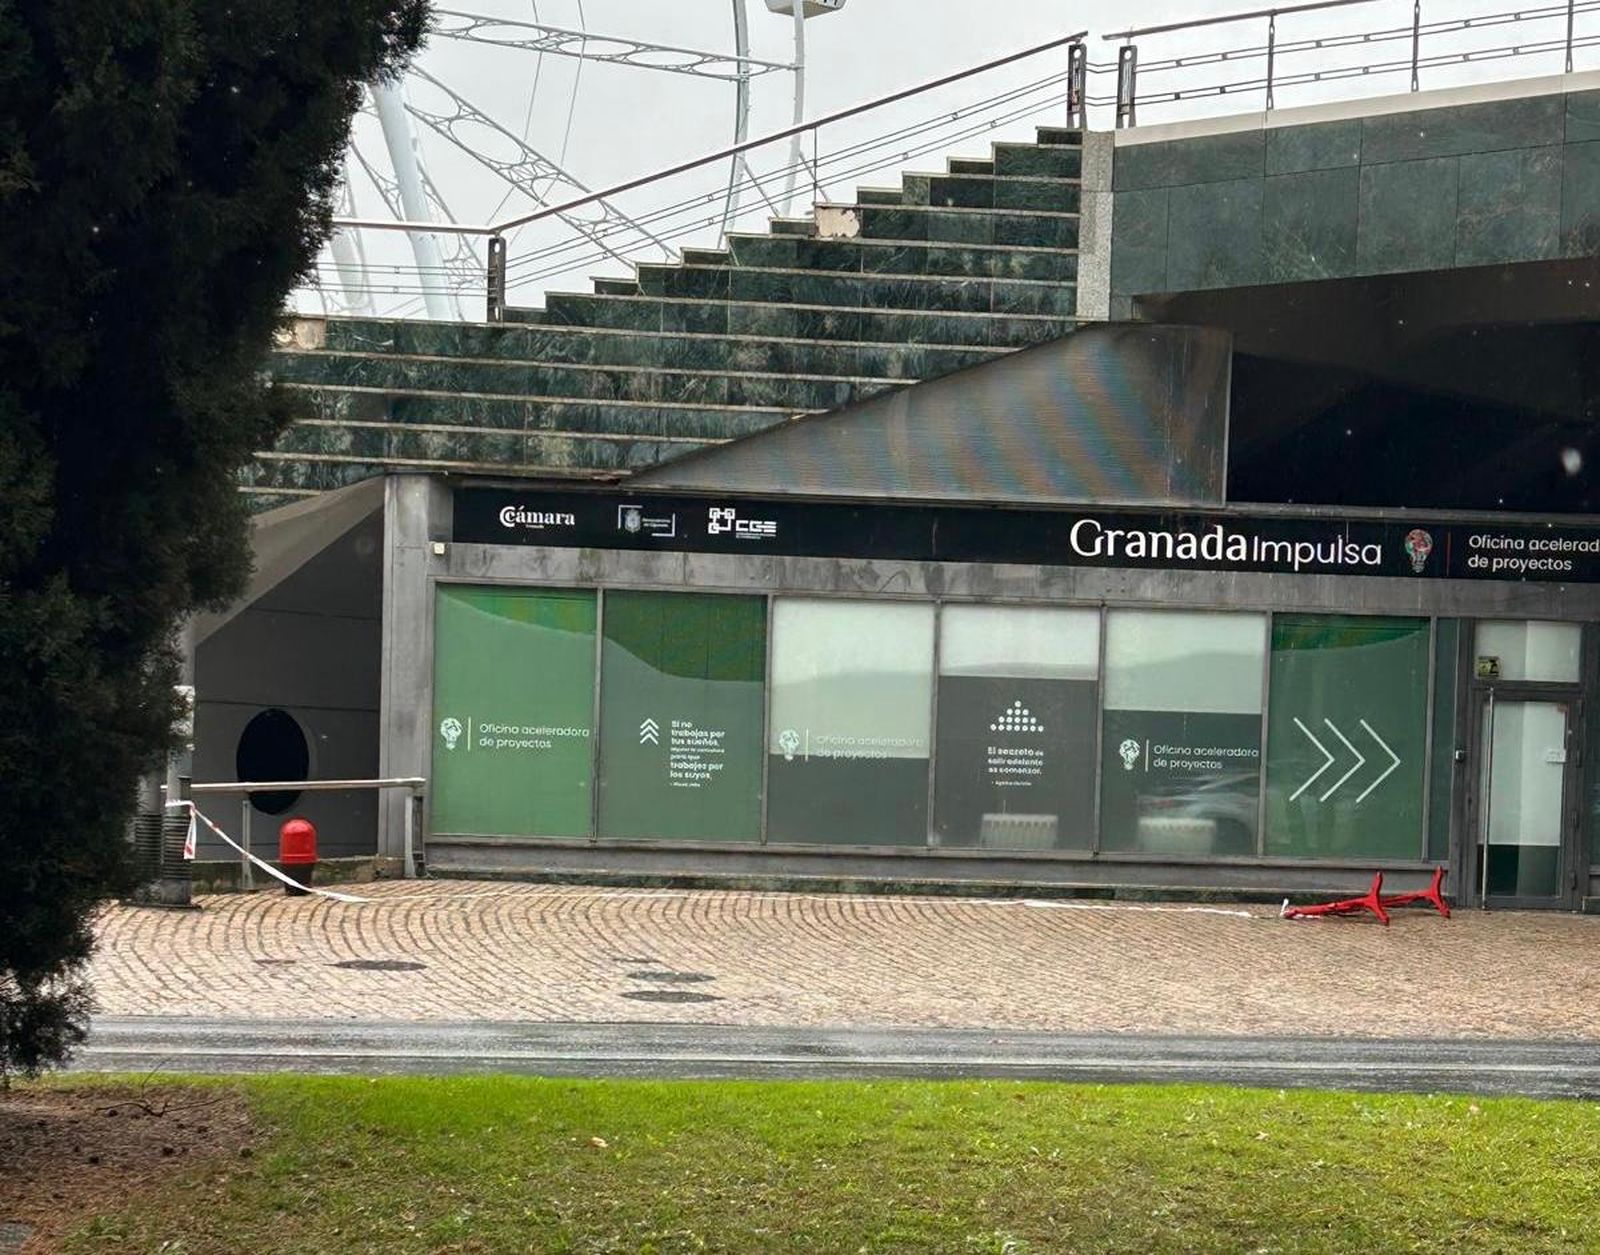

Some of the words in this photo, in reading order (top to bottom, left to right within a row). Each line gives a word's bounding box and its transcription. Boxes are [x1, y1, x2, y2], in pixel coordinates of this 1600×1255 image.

[1469, 534, 1525, 550] Oficina
[1528, 537, 1600, 553] acelerad
[1467, 554, 1489, 568] de
[1491, 556, 1573, 573] proyectos
[479, 723, 520, 734] Oficina
[521, 725, 590, 737] aceleradora
[479, 737, 494, 747] de
[496, 738, 552, 750] proyectos
[1153, 744, 1192, 755] Oficina
[1193, 745, 1260, 757] aceleradora
[816, 748, 831, 757] de
[832, 749, 888, 760] proyectos
[1153, 757, 1168, 767] de
[1170, 759, 1224, 771] proyectos
